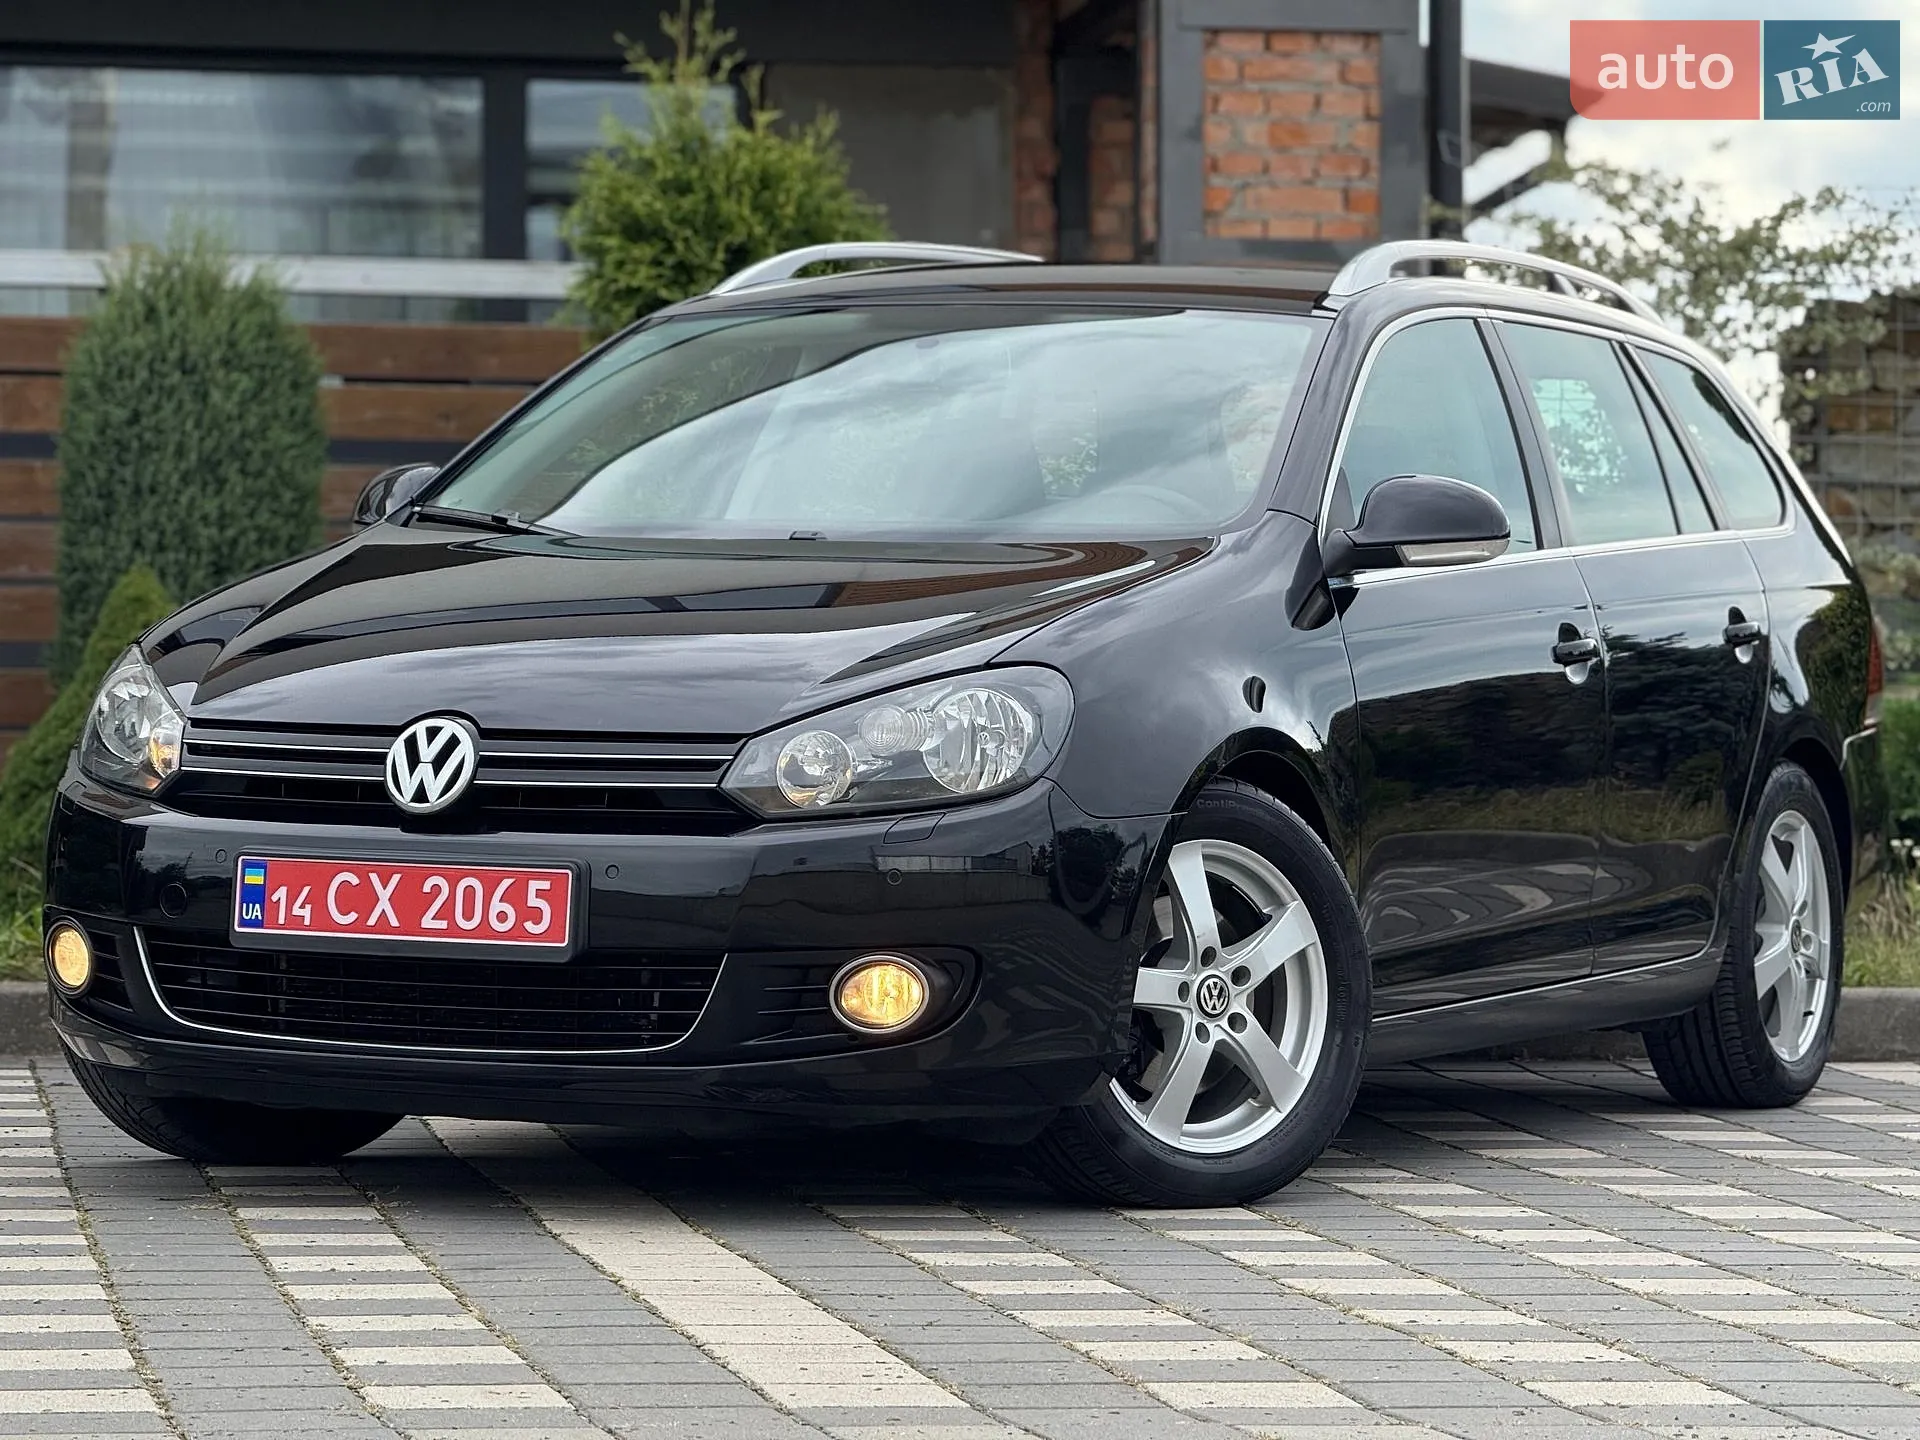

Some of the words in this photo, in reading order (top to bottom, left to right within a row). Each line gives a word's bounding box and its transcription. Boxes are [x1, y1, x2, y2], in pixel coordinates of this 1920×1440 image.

[389, 719, 472, 806] VW
[242, 903, 262, 920] UA
[270, 885, 312, 926] 14
[327, 871, 402, 927] CX
[420, 875, 552, 935] 2065
